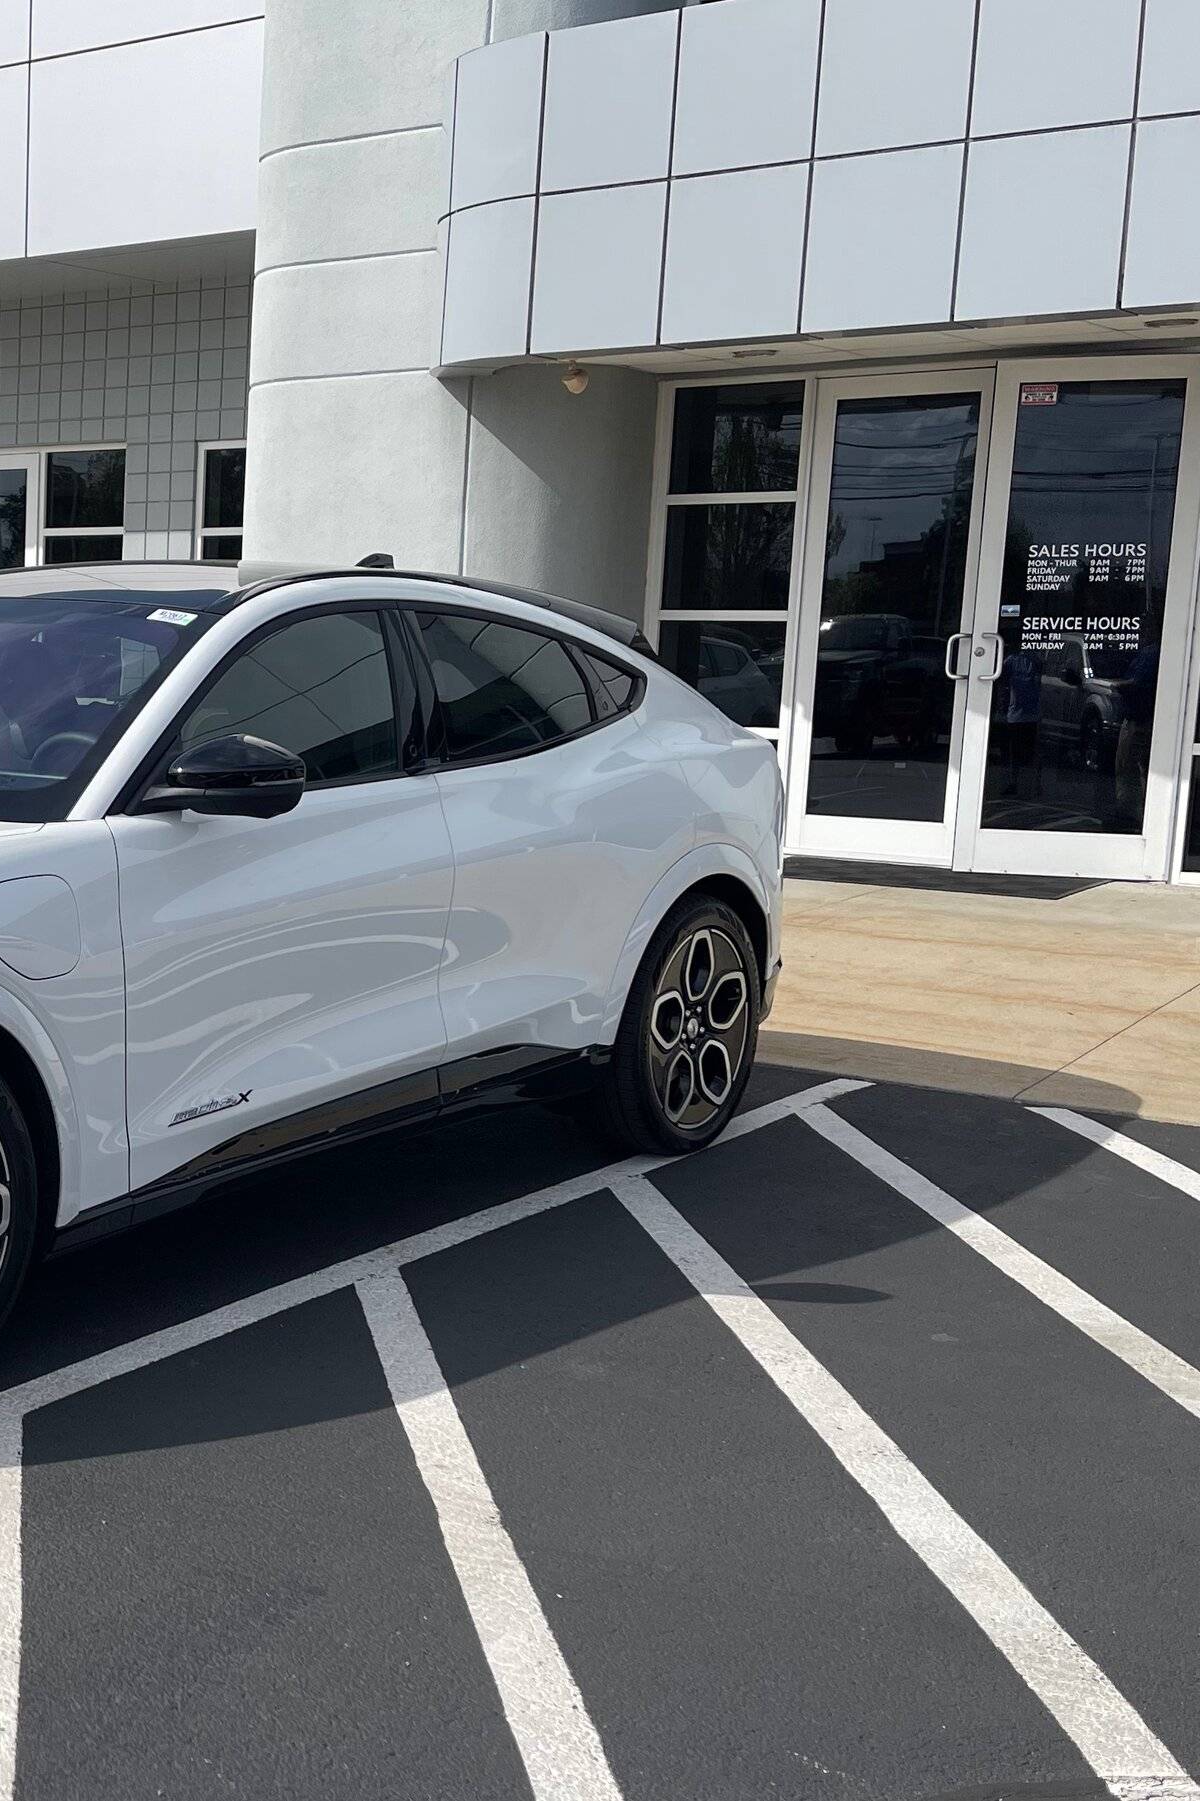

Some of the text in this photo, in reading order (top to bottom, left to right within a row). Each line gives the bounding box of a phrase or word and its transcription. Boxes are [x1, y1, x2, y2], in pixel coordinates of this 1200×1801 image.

[1028, 543, 1146, 558] SALES HOURS
[1022, 617, 1140, 630] SERVICE HOURS
